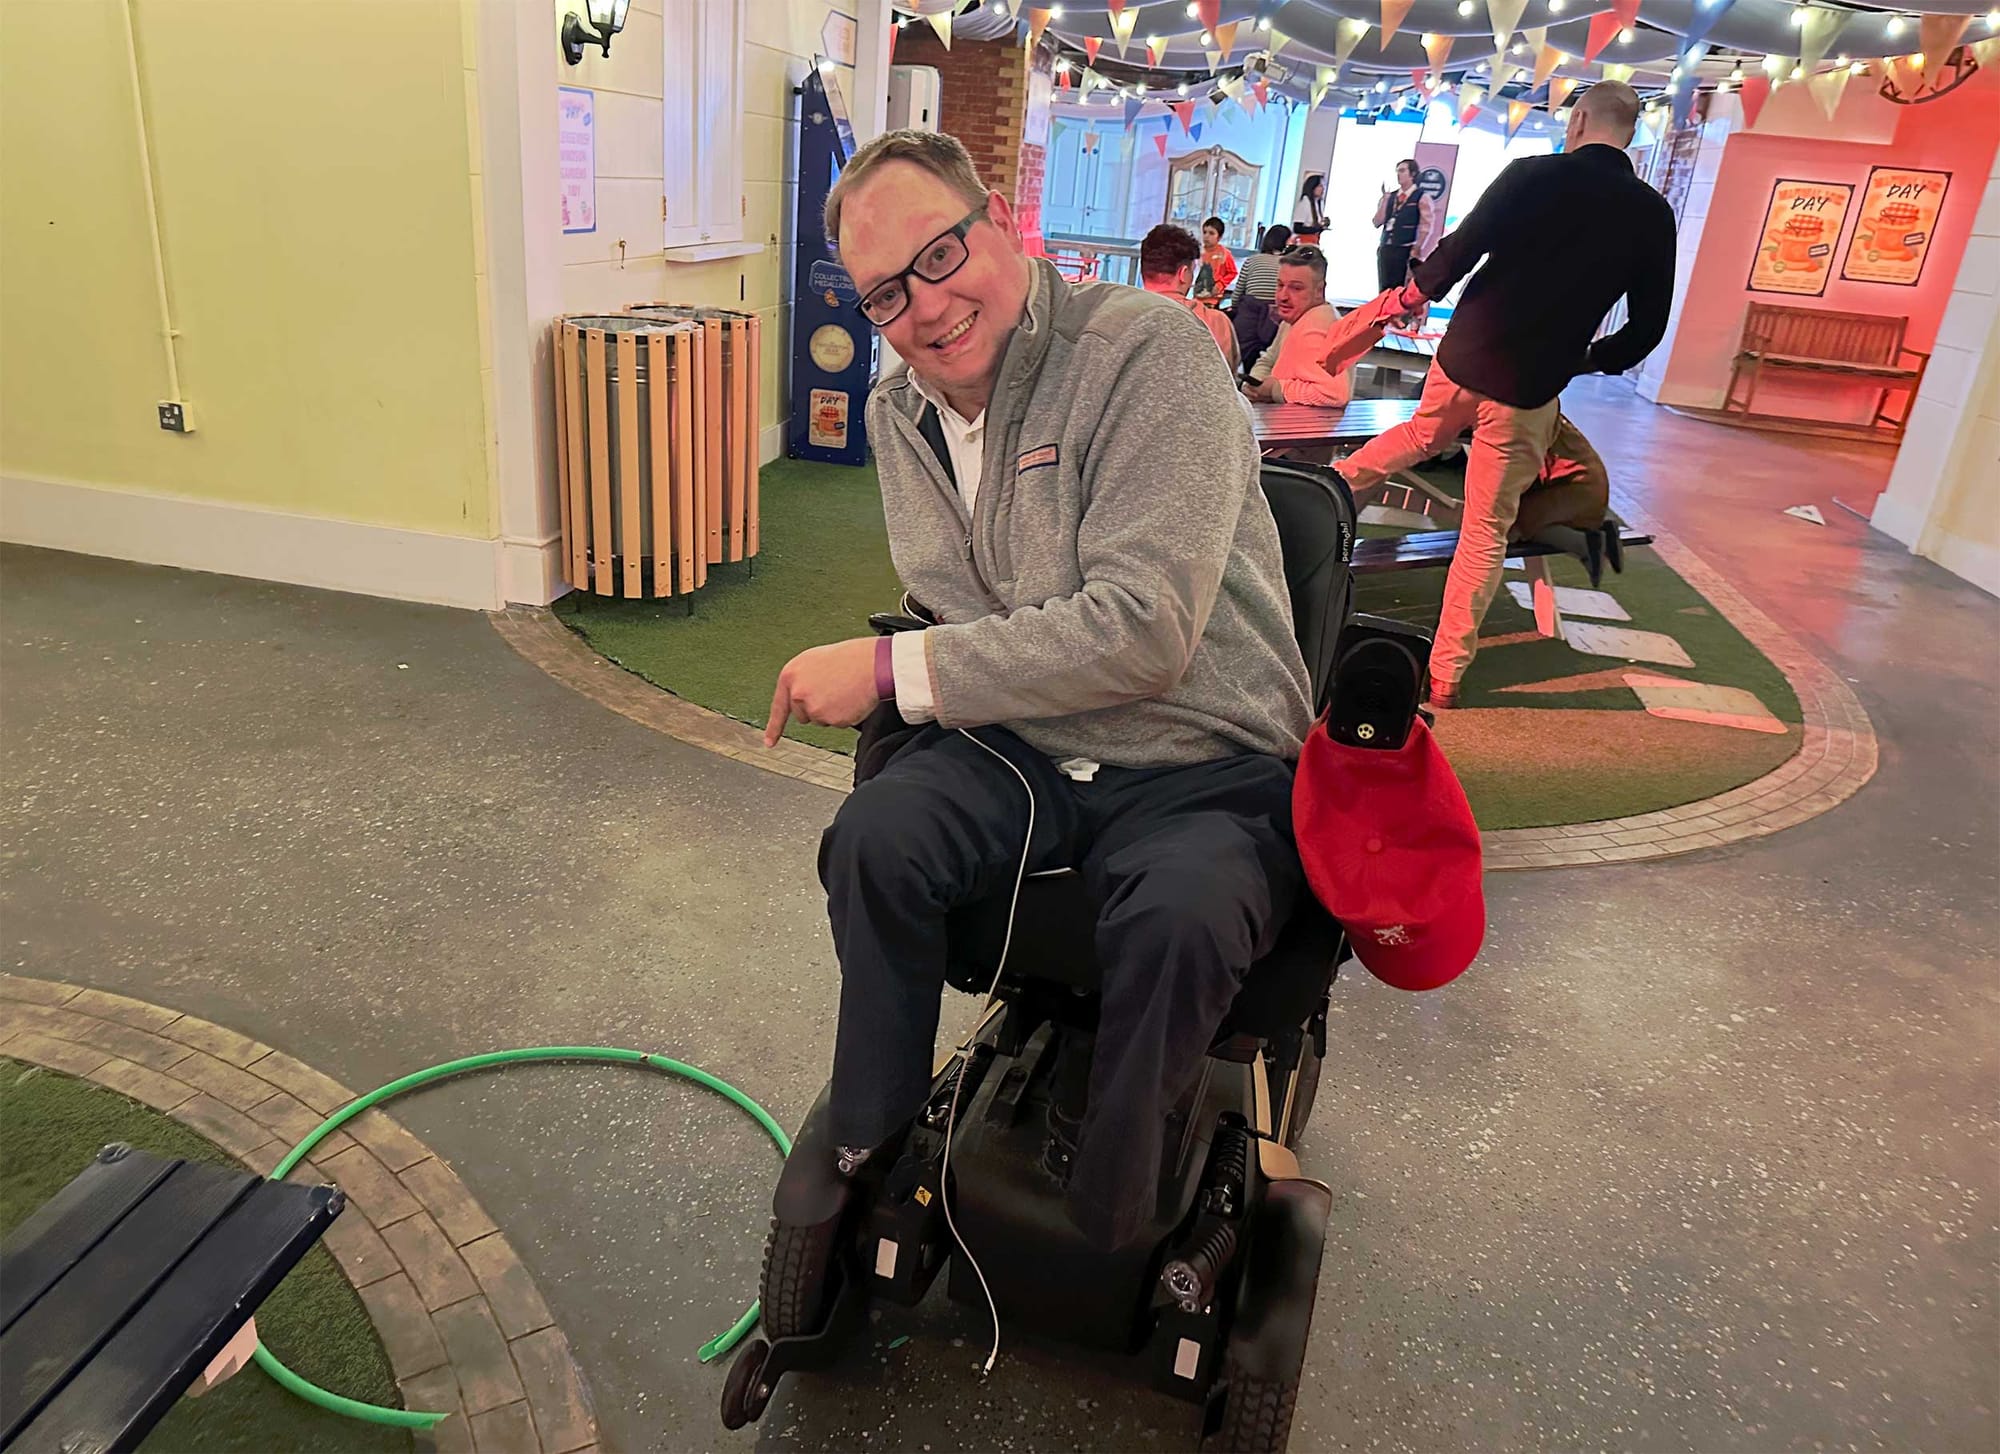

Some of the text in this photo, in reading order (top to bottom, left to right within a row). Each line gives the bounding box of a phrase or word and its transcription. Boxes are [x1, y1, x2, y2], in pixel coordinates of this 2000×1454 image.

[1886, 183, 1927, 200] DAY
[1790, 196, 1830, 212] DAY
[820, 396, 840, 405] DAY
[1340, 522, 1351, 562] permobil
